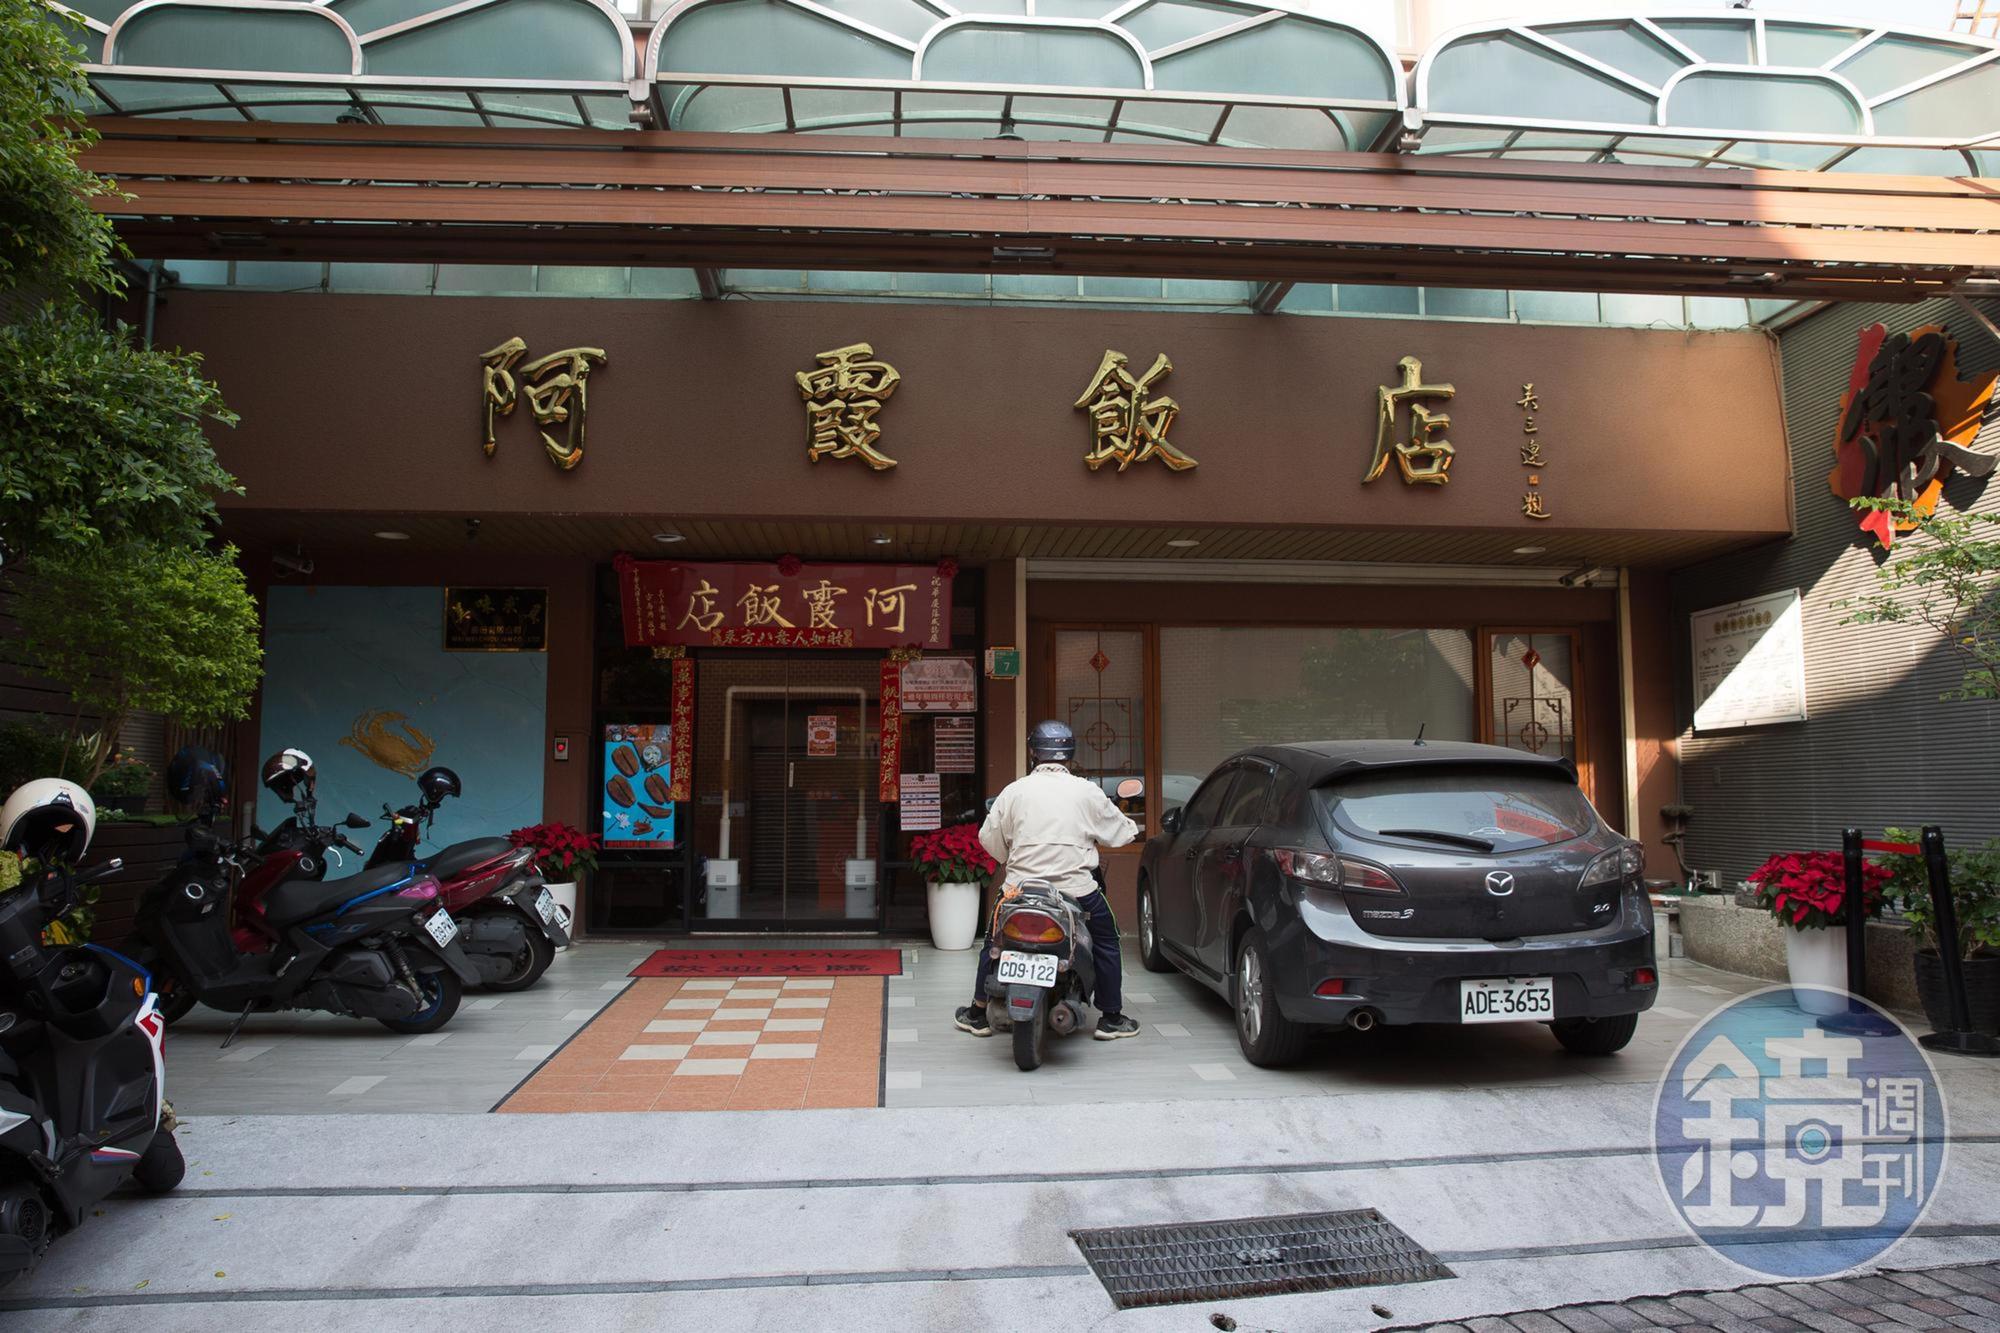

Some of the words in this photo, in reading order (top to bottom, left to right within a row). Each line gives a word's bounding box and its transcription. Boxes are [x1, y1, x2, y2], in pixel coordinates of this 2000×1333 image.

[479, 336, 1456, 486] 阿霞飯店
[1003, 661, 1011, 671] 7
